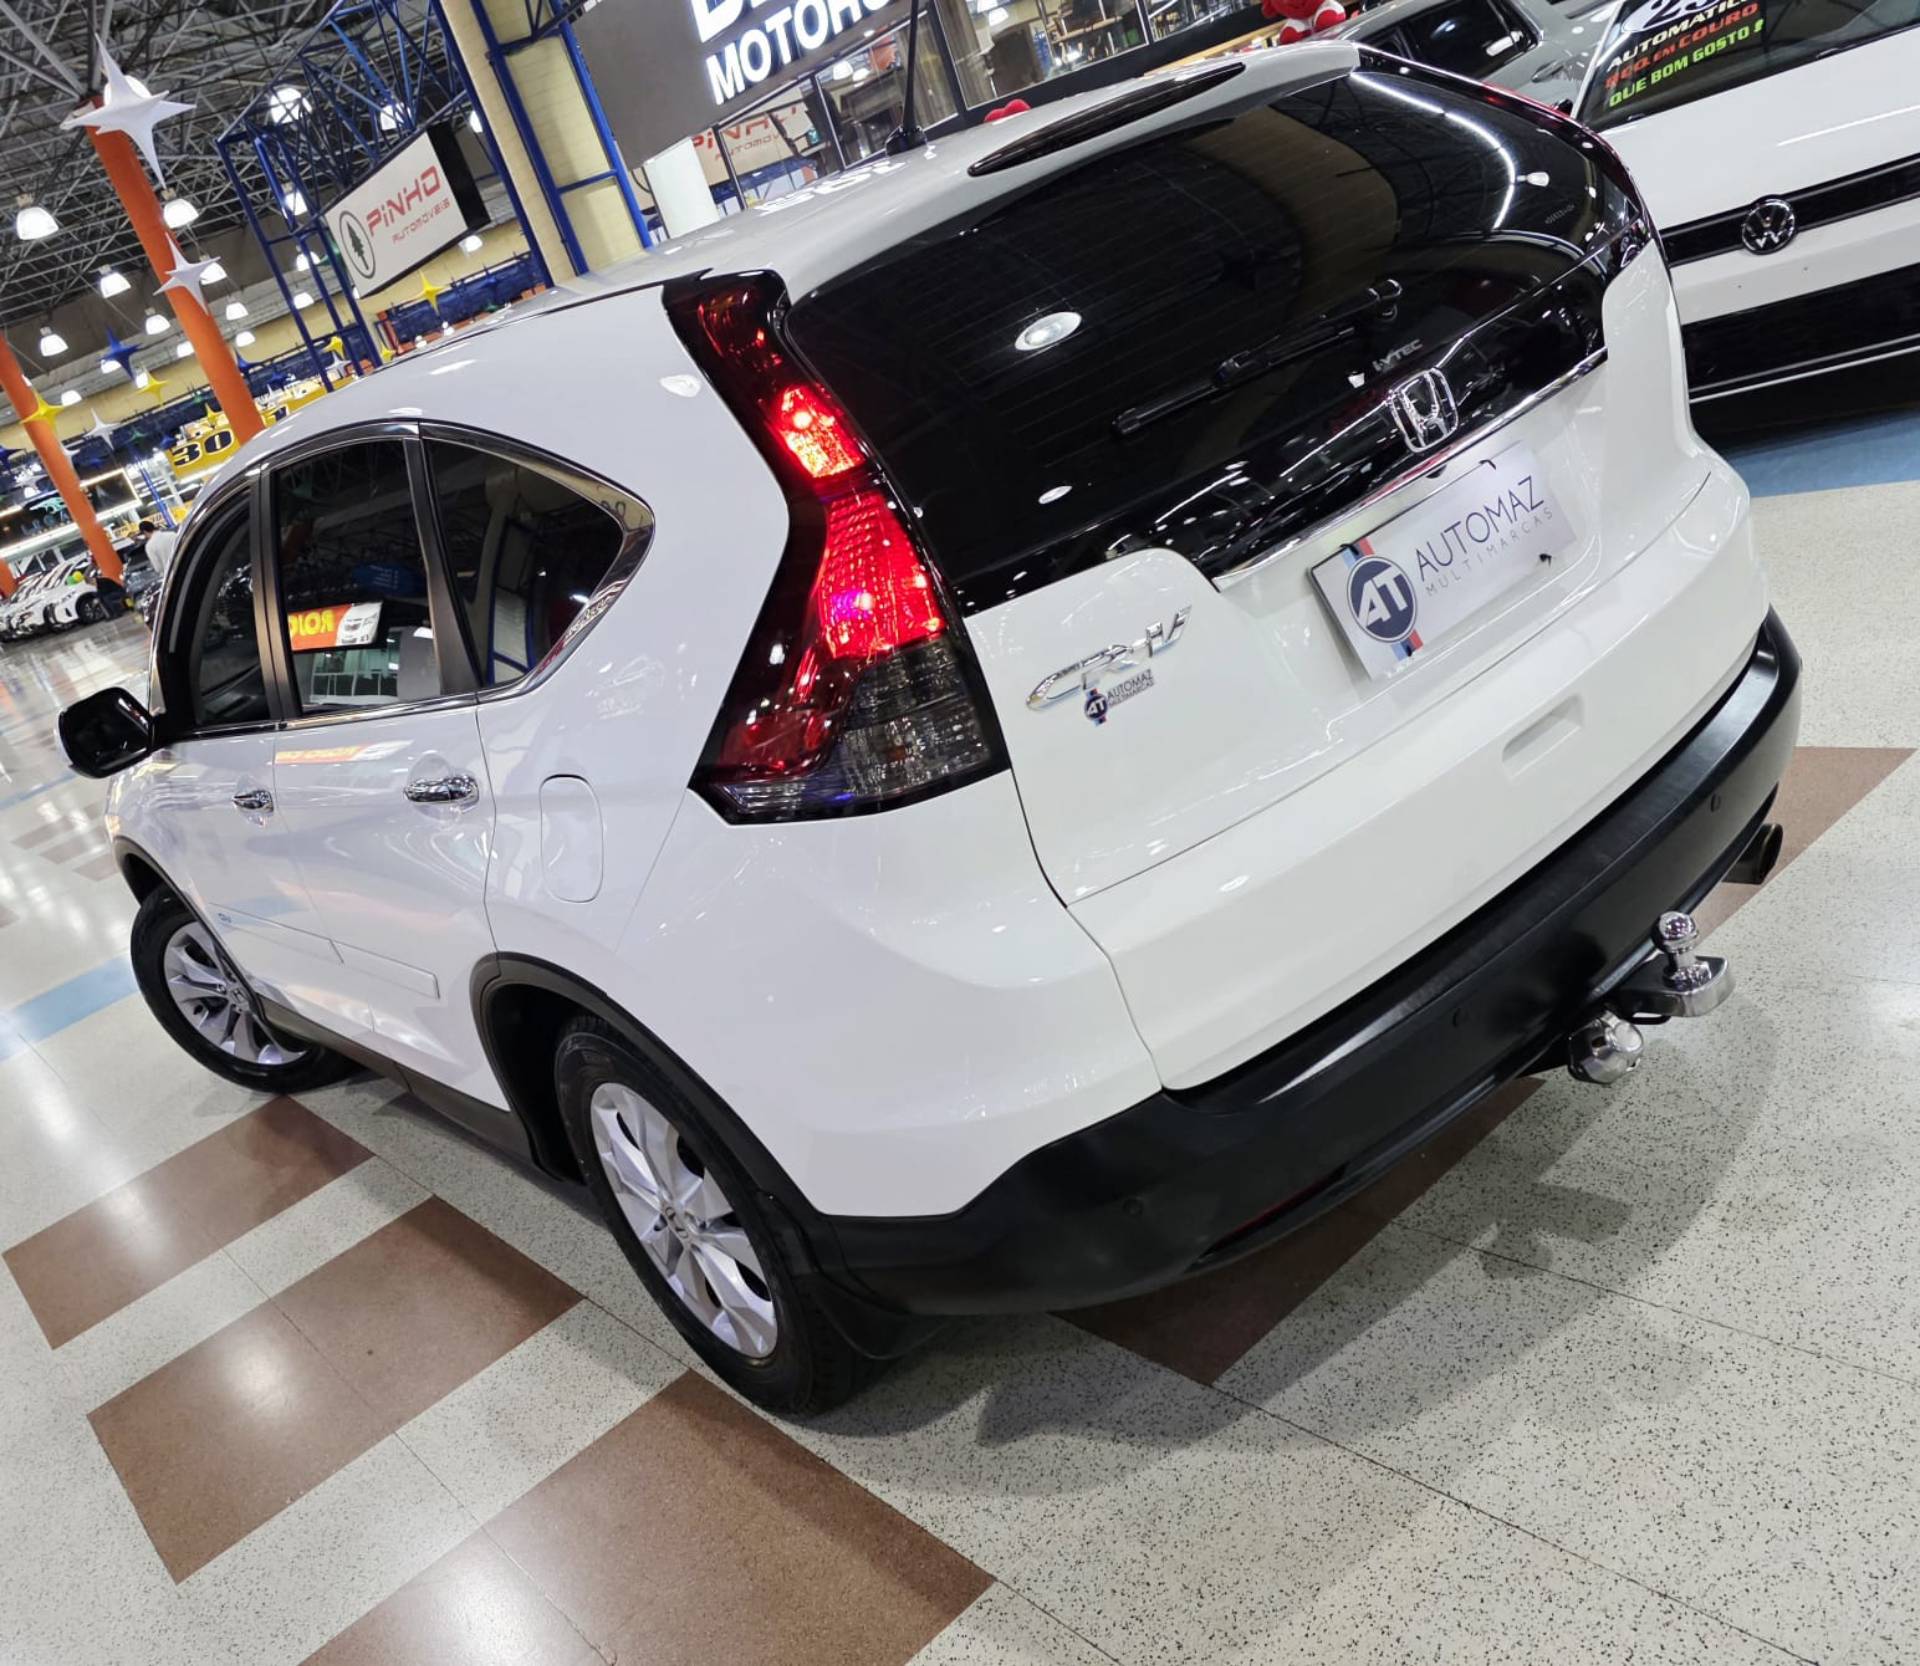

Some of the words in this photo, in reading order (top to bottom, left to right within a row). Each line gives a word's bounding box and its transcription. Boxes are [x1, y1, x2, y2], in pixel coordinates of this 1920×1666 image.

[706, 0, 892, 105] MOTOR
[1606, 0, 1748, 72] AUTOMATIC
[1609, 77, 1648, 108] QUE
[1651, 55, 1689, 84] BOM
[1692, 25, 1750, 63] GOSTO
[1678, 2, 1760, 49] COURO
[1415, 475, 1544, 582] AUTOMAZ
[1425, 508, 1553, 598] MULTIMARCAS
[1106, 668, 1154, 699] AUTOMAZ
